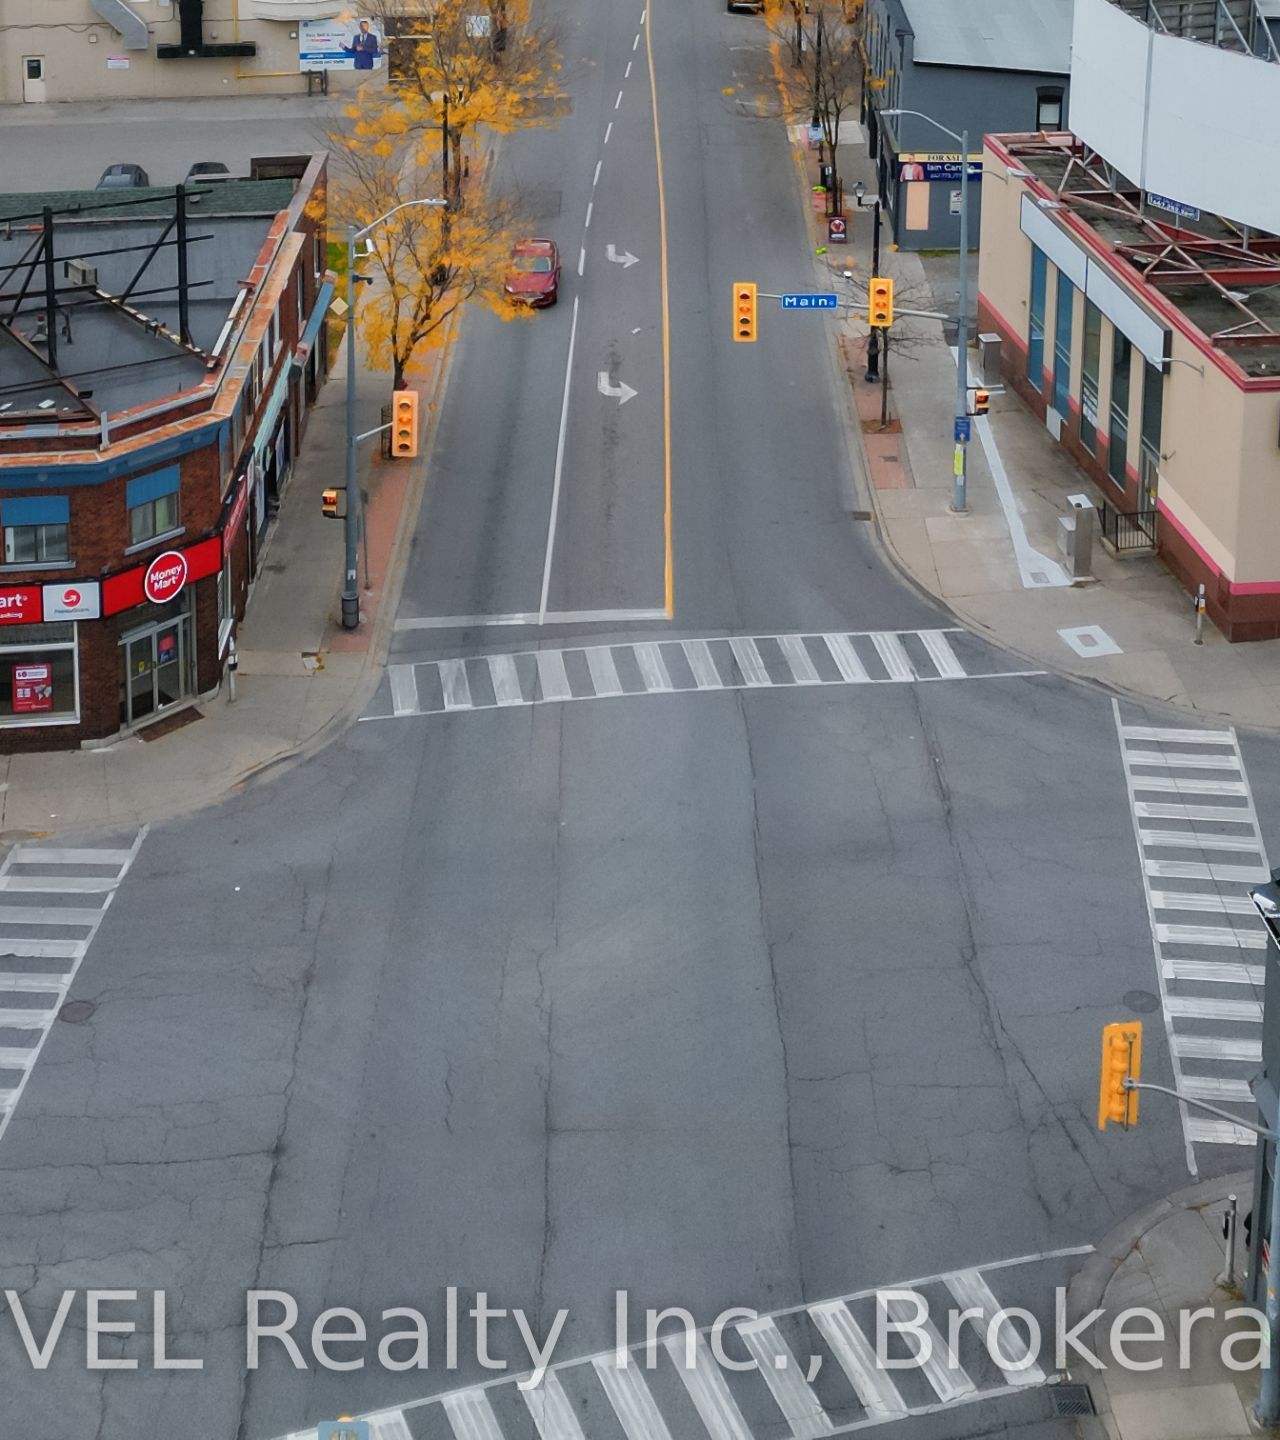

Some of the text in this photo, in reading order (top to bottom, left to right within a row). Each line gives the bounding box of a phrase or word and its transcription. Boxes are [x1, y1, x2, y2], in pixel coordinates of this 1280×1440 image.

[927, 154, 944, 162] FOR
[785, 297, 827, 307] Main
[150, 564, 182, 584] Money
[154, 576, 178, 592] Mart
